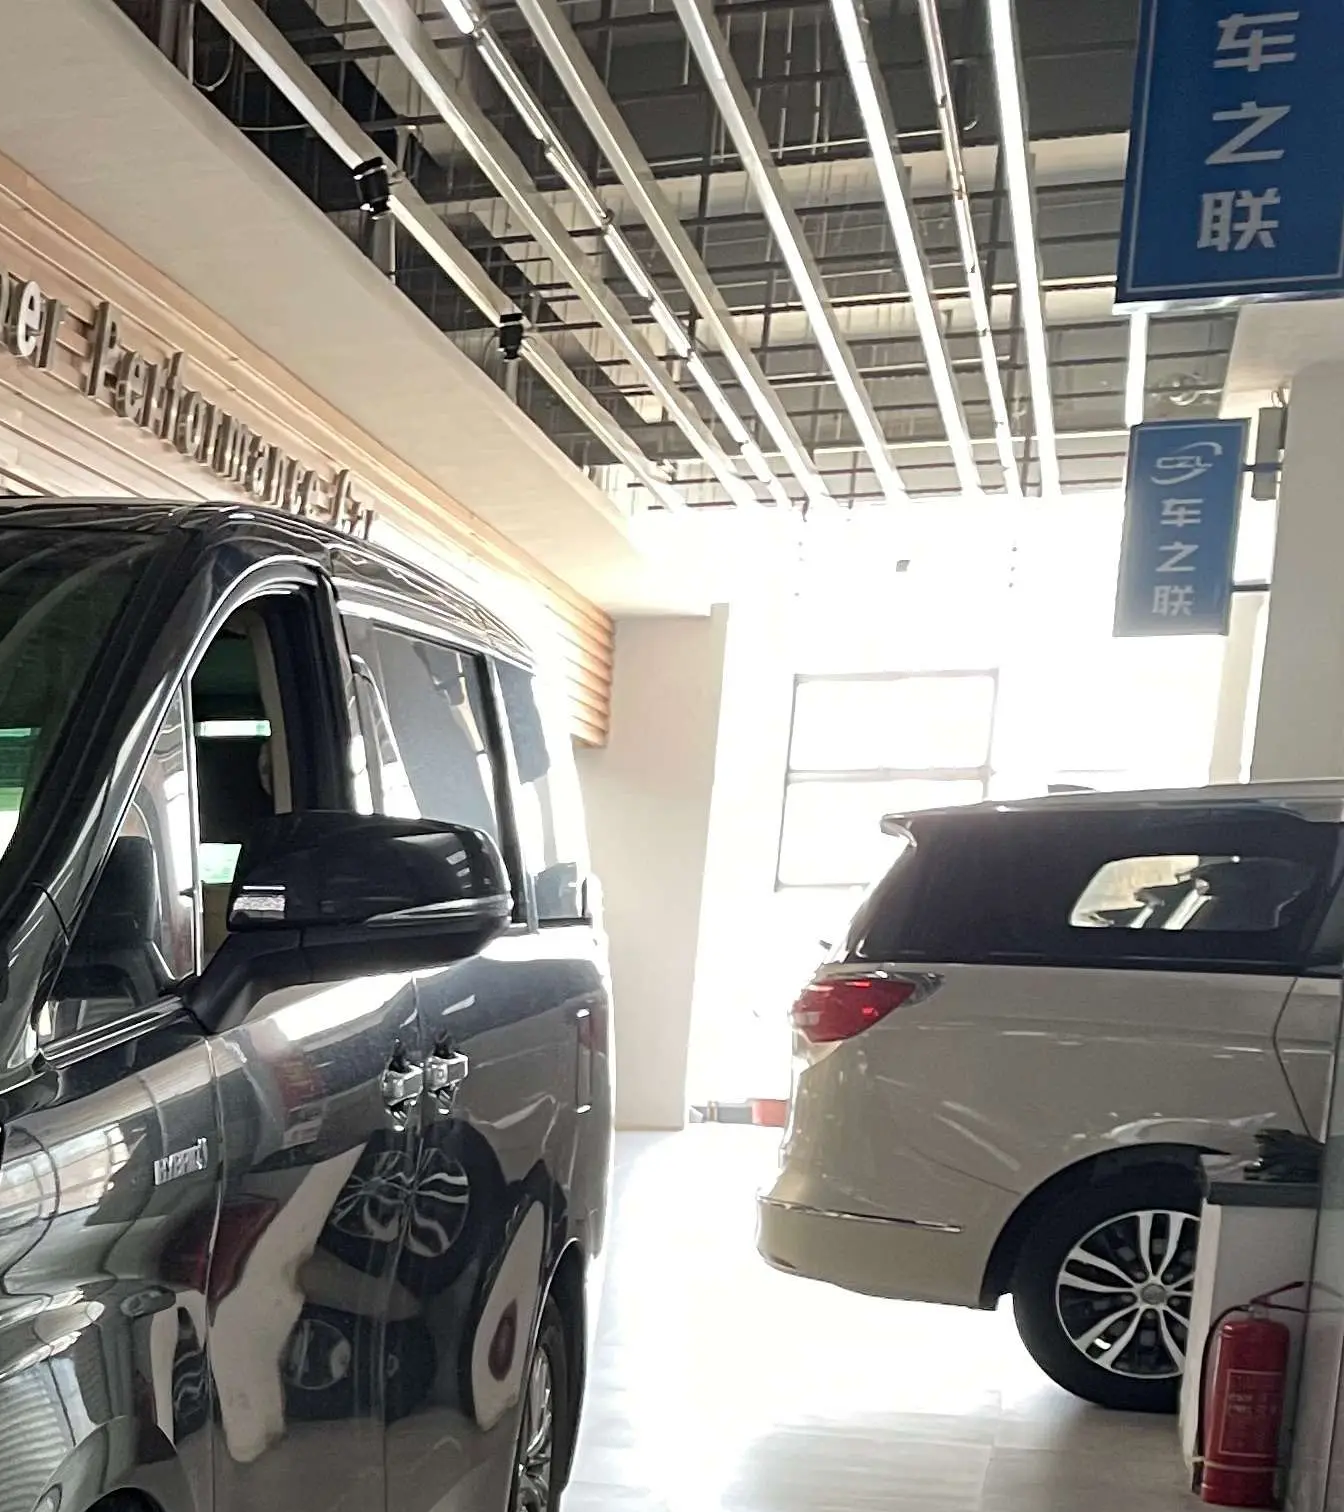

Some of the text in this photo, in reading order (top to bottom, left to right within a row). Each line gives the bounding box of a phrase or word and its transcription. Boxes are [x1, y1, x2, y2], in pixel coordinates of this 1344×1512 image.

[1197, 11, 1300, 253] 车之联
[1152, 499, 1204, 616] 车之联
